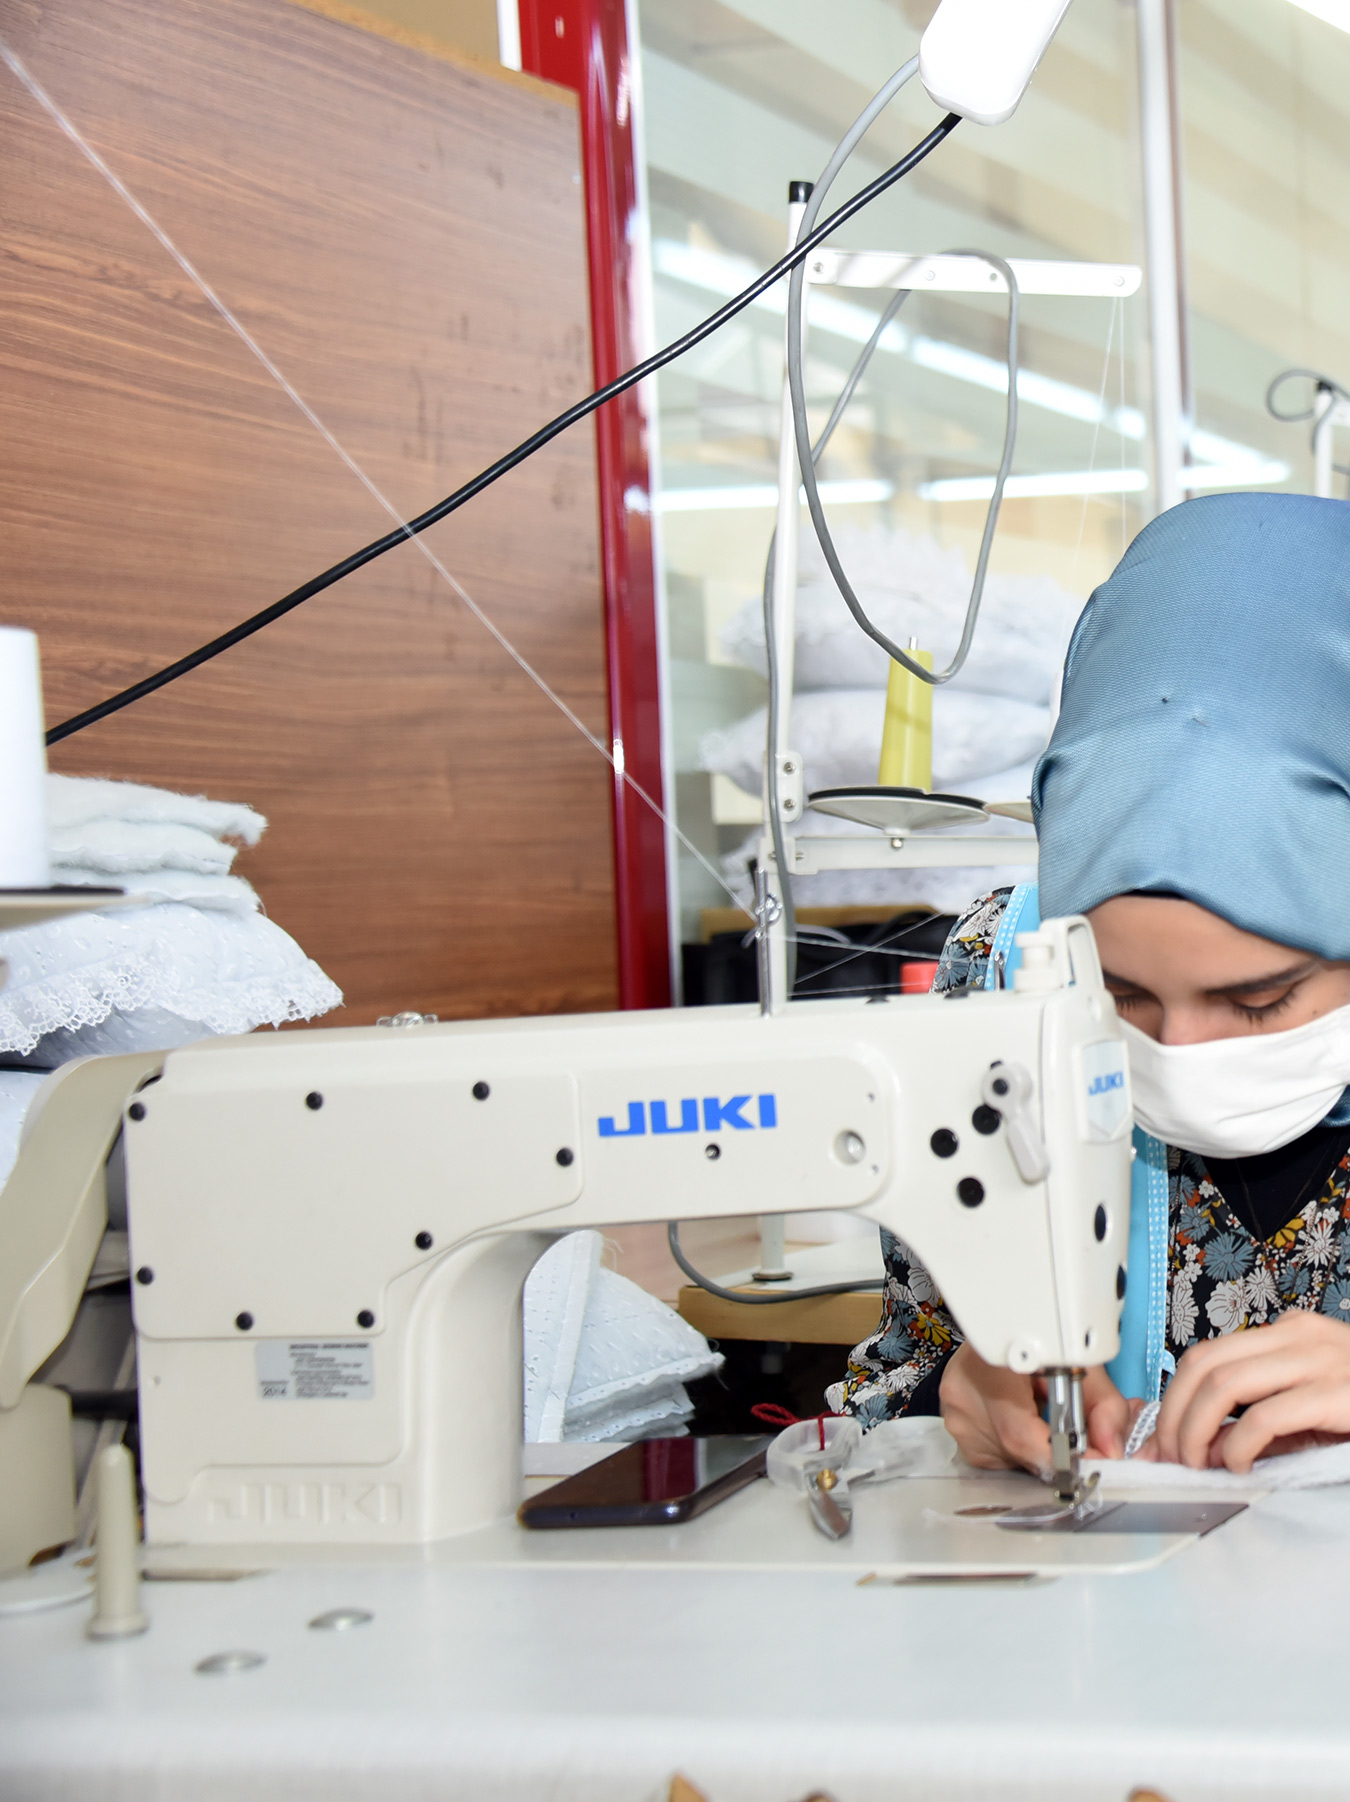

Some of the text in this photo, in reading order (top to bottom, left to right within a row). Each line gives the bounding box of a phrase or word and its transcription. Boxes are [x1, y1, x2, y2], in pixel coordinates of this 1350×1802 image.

[1088, 1072, 1124, 1096] JUKI
[598, 1093, 777, 1137] JUKI
[207, 1483, 402, 1524] JUKI
